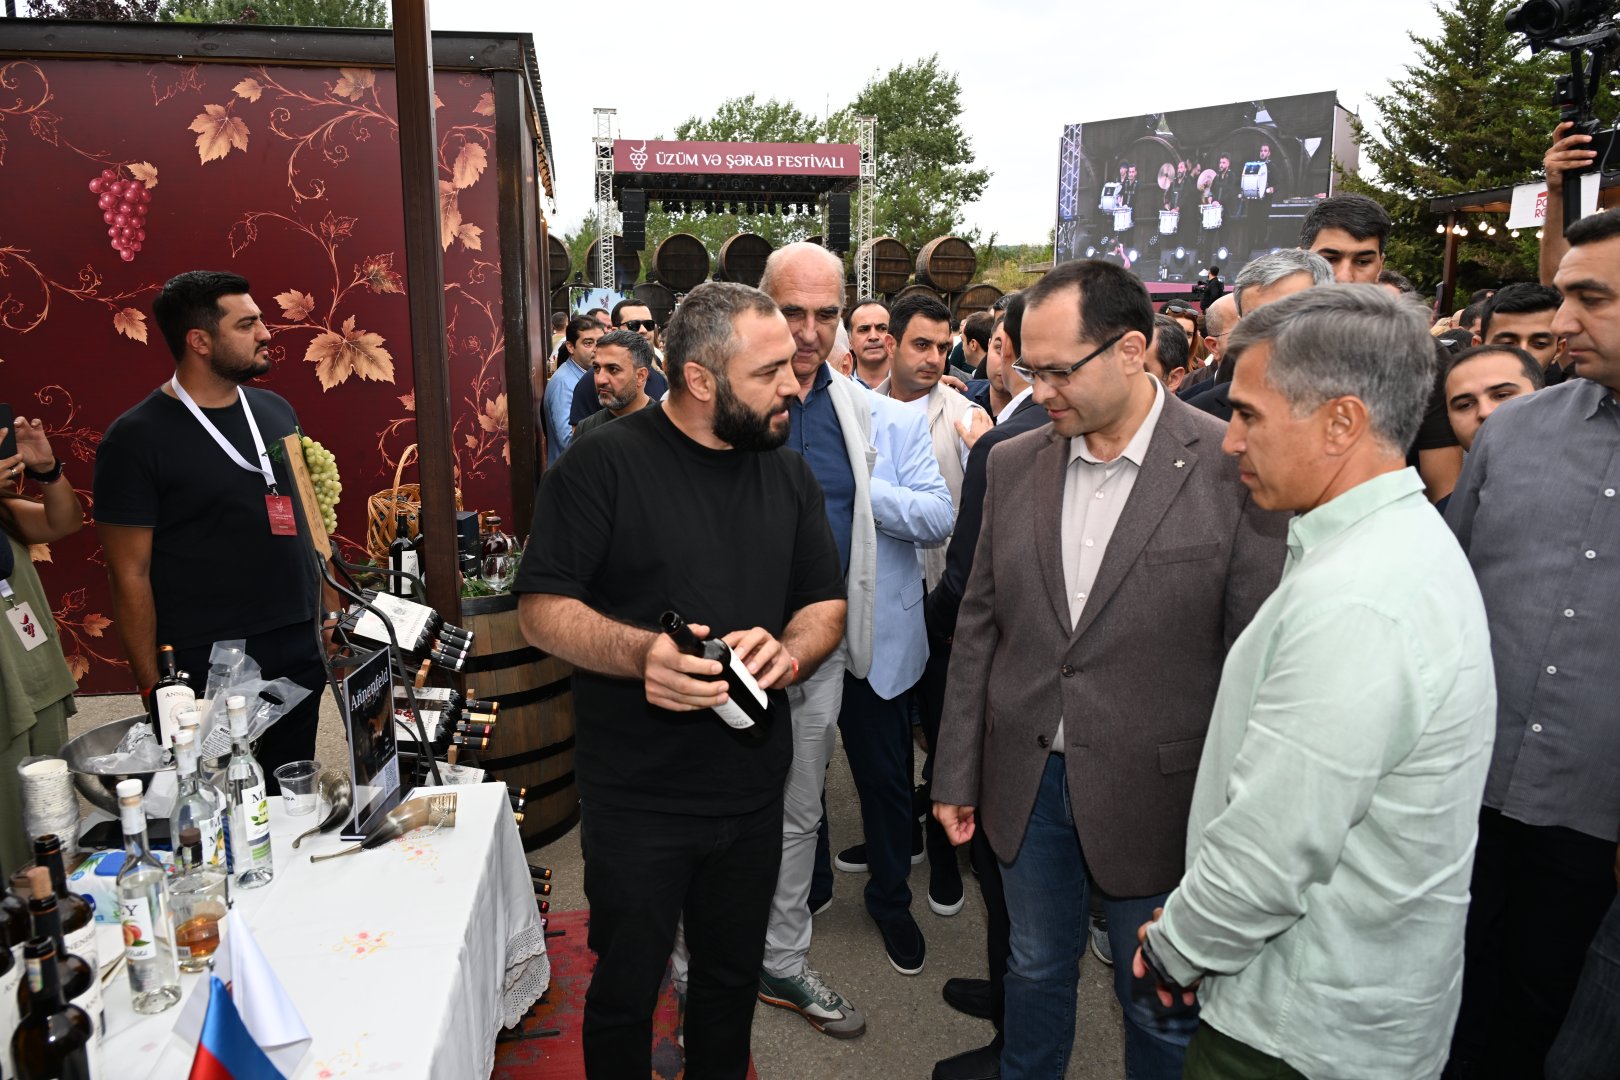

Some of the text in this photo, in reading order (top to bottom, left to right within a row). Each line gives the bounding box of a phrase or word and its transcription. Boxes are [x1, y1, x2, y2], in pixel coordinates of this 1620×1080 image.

[656, 151, 845, 169] ÜZÜM VƏ ŞƏRAB FESTİVALI
[350, 667, 389, 712] Annenfeld
